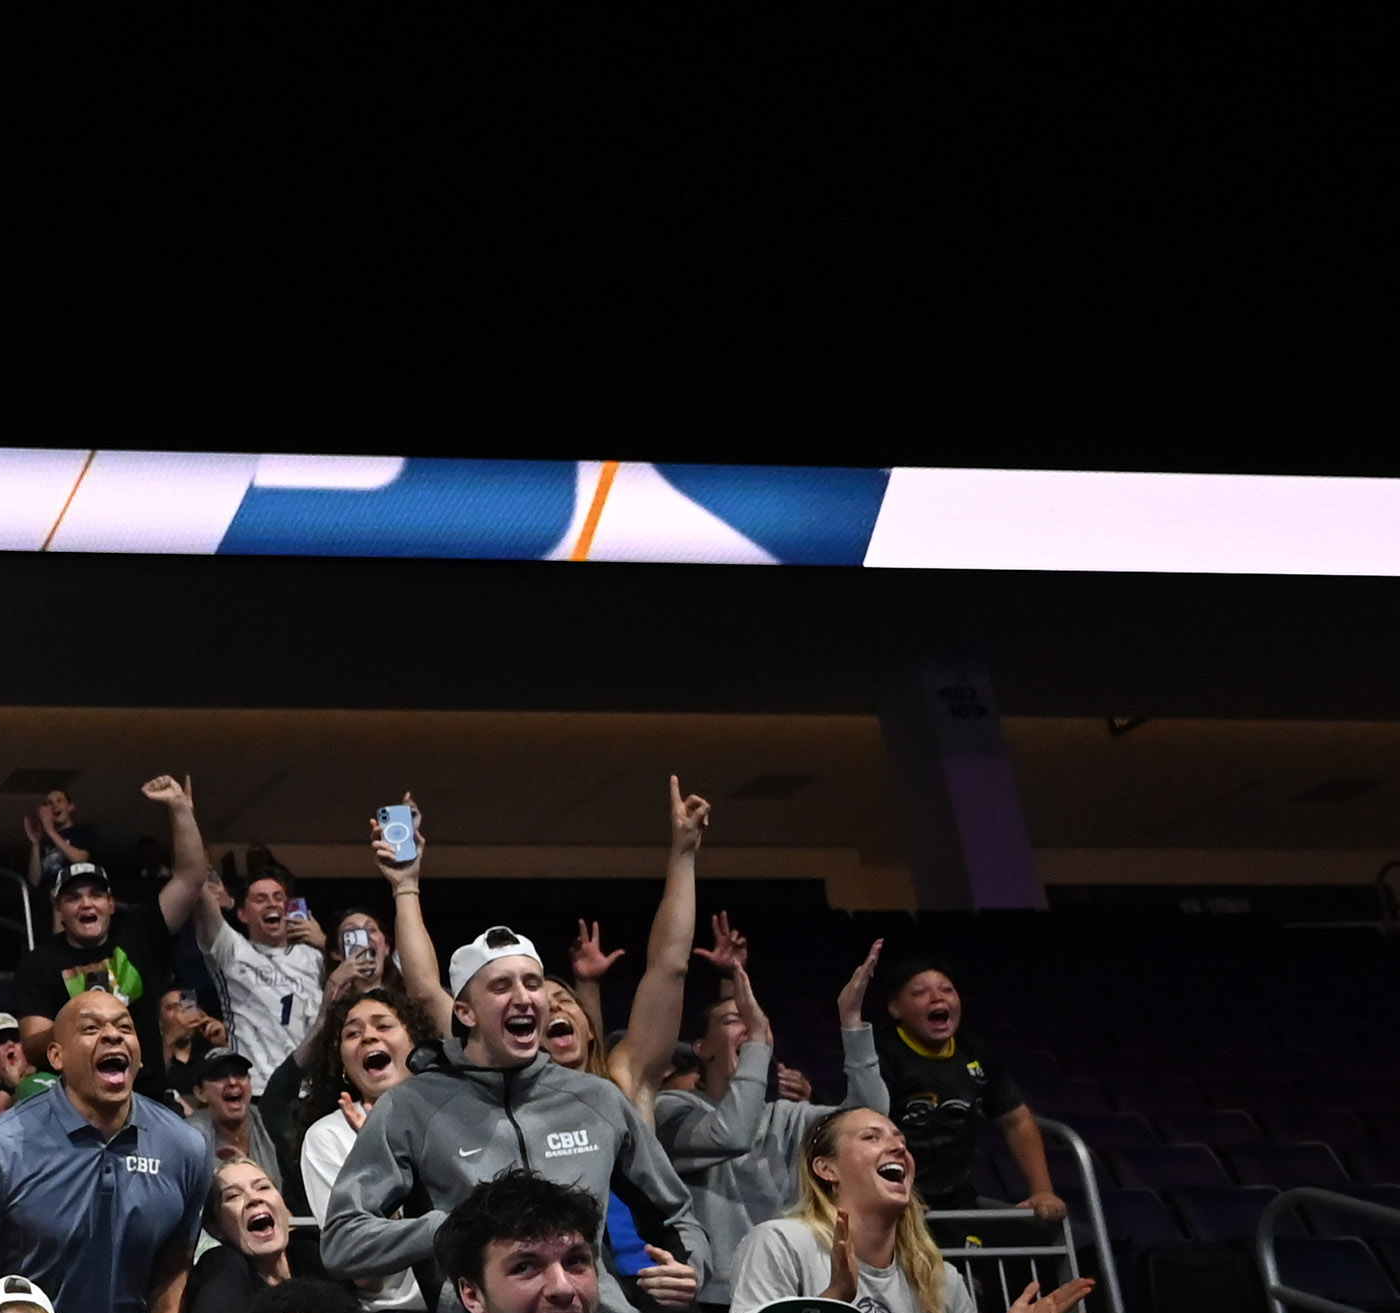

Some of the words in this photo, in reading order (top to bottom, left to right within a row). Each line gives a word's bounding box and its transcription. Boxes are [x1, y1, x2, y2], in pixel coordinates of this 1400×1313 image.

[280, 993, 294, 1027] 1
[547, 1130, 589, 1150] CBU
[545, 1144, 599, 1158] BASKETBALL
[126, 1155, 161, 1174] CBU
